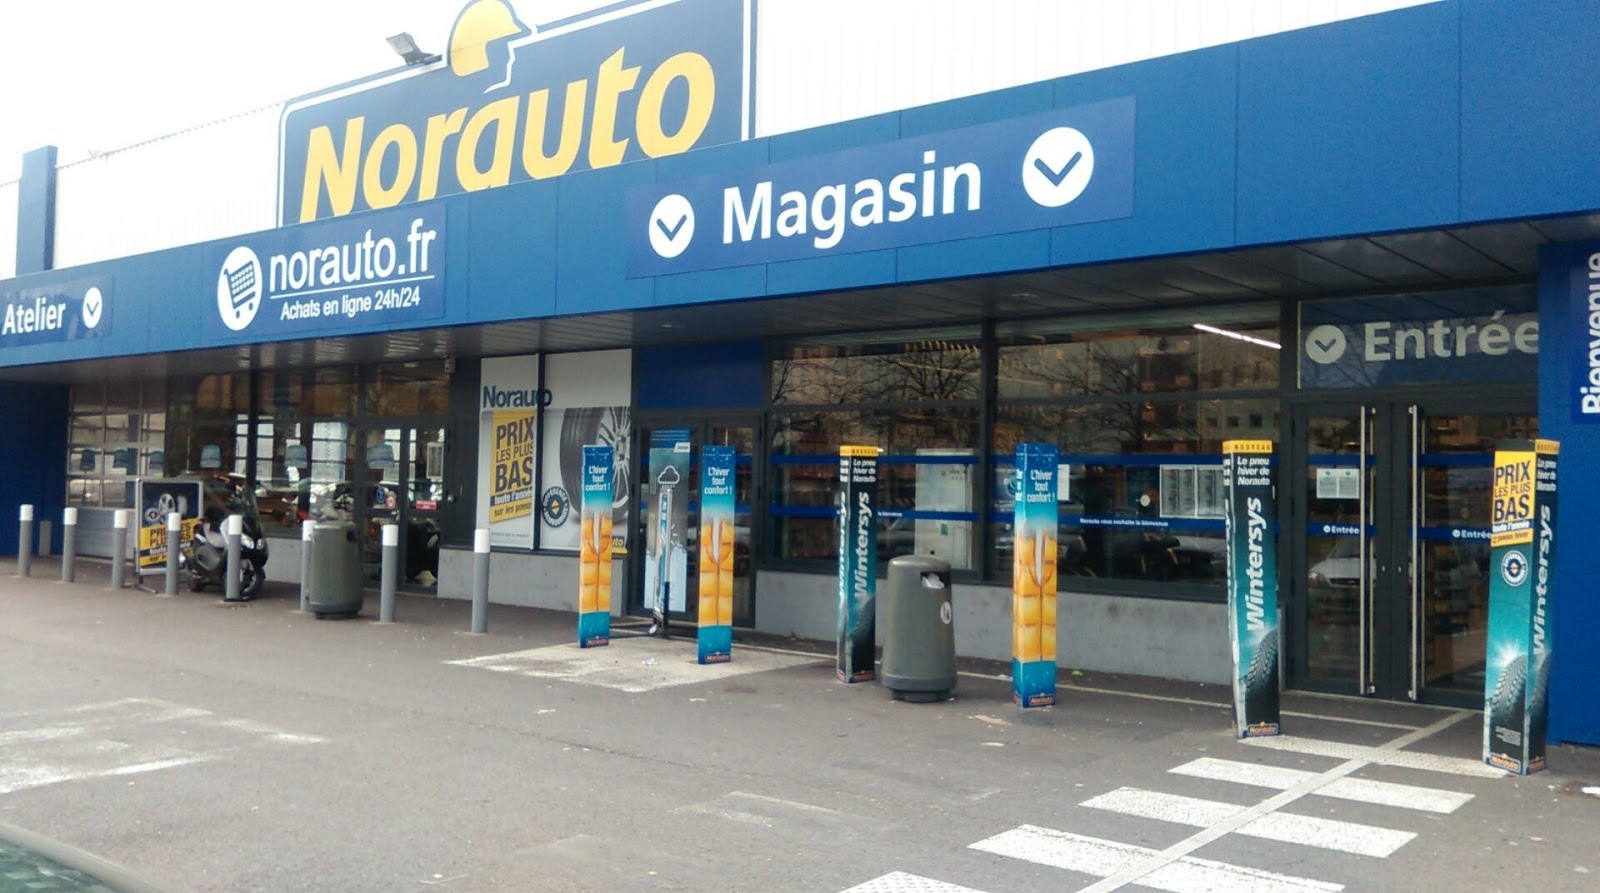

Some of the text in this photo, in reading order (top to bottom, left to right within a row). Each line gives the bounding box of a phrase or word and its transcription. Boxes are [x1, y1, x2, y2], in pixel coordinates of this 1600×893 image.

[299, 46, 715, 223] Norauto
[723, 150, 981, 250] Magasin
[270, 218, 437, 291] norauto.fr
[281, 289, 420, 321] Achats en ligne 24h/24
[2, 297, 67, 335] Atelier
[1364, 310, 1539, 362] Entrée
[496, 416, 534, 449] PRIX
[496, 449, 511, 463] LES
[1237, 456, 1270, 467] Le pneu
[495, 456, 533, 493] BAS
[588, 465, 608, 474] L'hiver
[708, 466, 730, 476] L'hiver
[1030, 469, 1053, 480] L'hiver
[1237, 466, 1270, 475] hiver de
[1495, 460, 1531, 486] PRIX
[585, 483, 606, 491] confort
[712, 477, 725, 485] tout
[1035, 482, 1049, 491] tout
[1237, 477, 1271, 486] Norauto
[704, 486, 728, 494] confort
[1494, 481, 1531, 497] LES PLUS
[1027, 492, 1052, 502] confort
[505, 505, 514, 514] les
[1494, 494, 1530, 523] BAS
[1331, 525, 1360, 534] Entrée
[1461, 529, 1491, 539] Entrée
[854, 491, 872, 598] Wintersys
[1246, 497, 1267, 632] Wintersys
[1533, 504, 1553, 655] Wintersys
